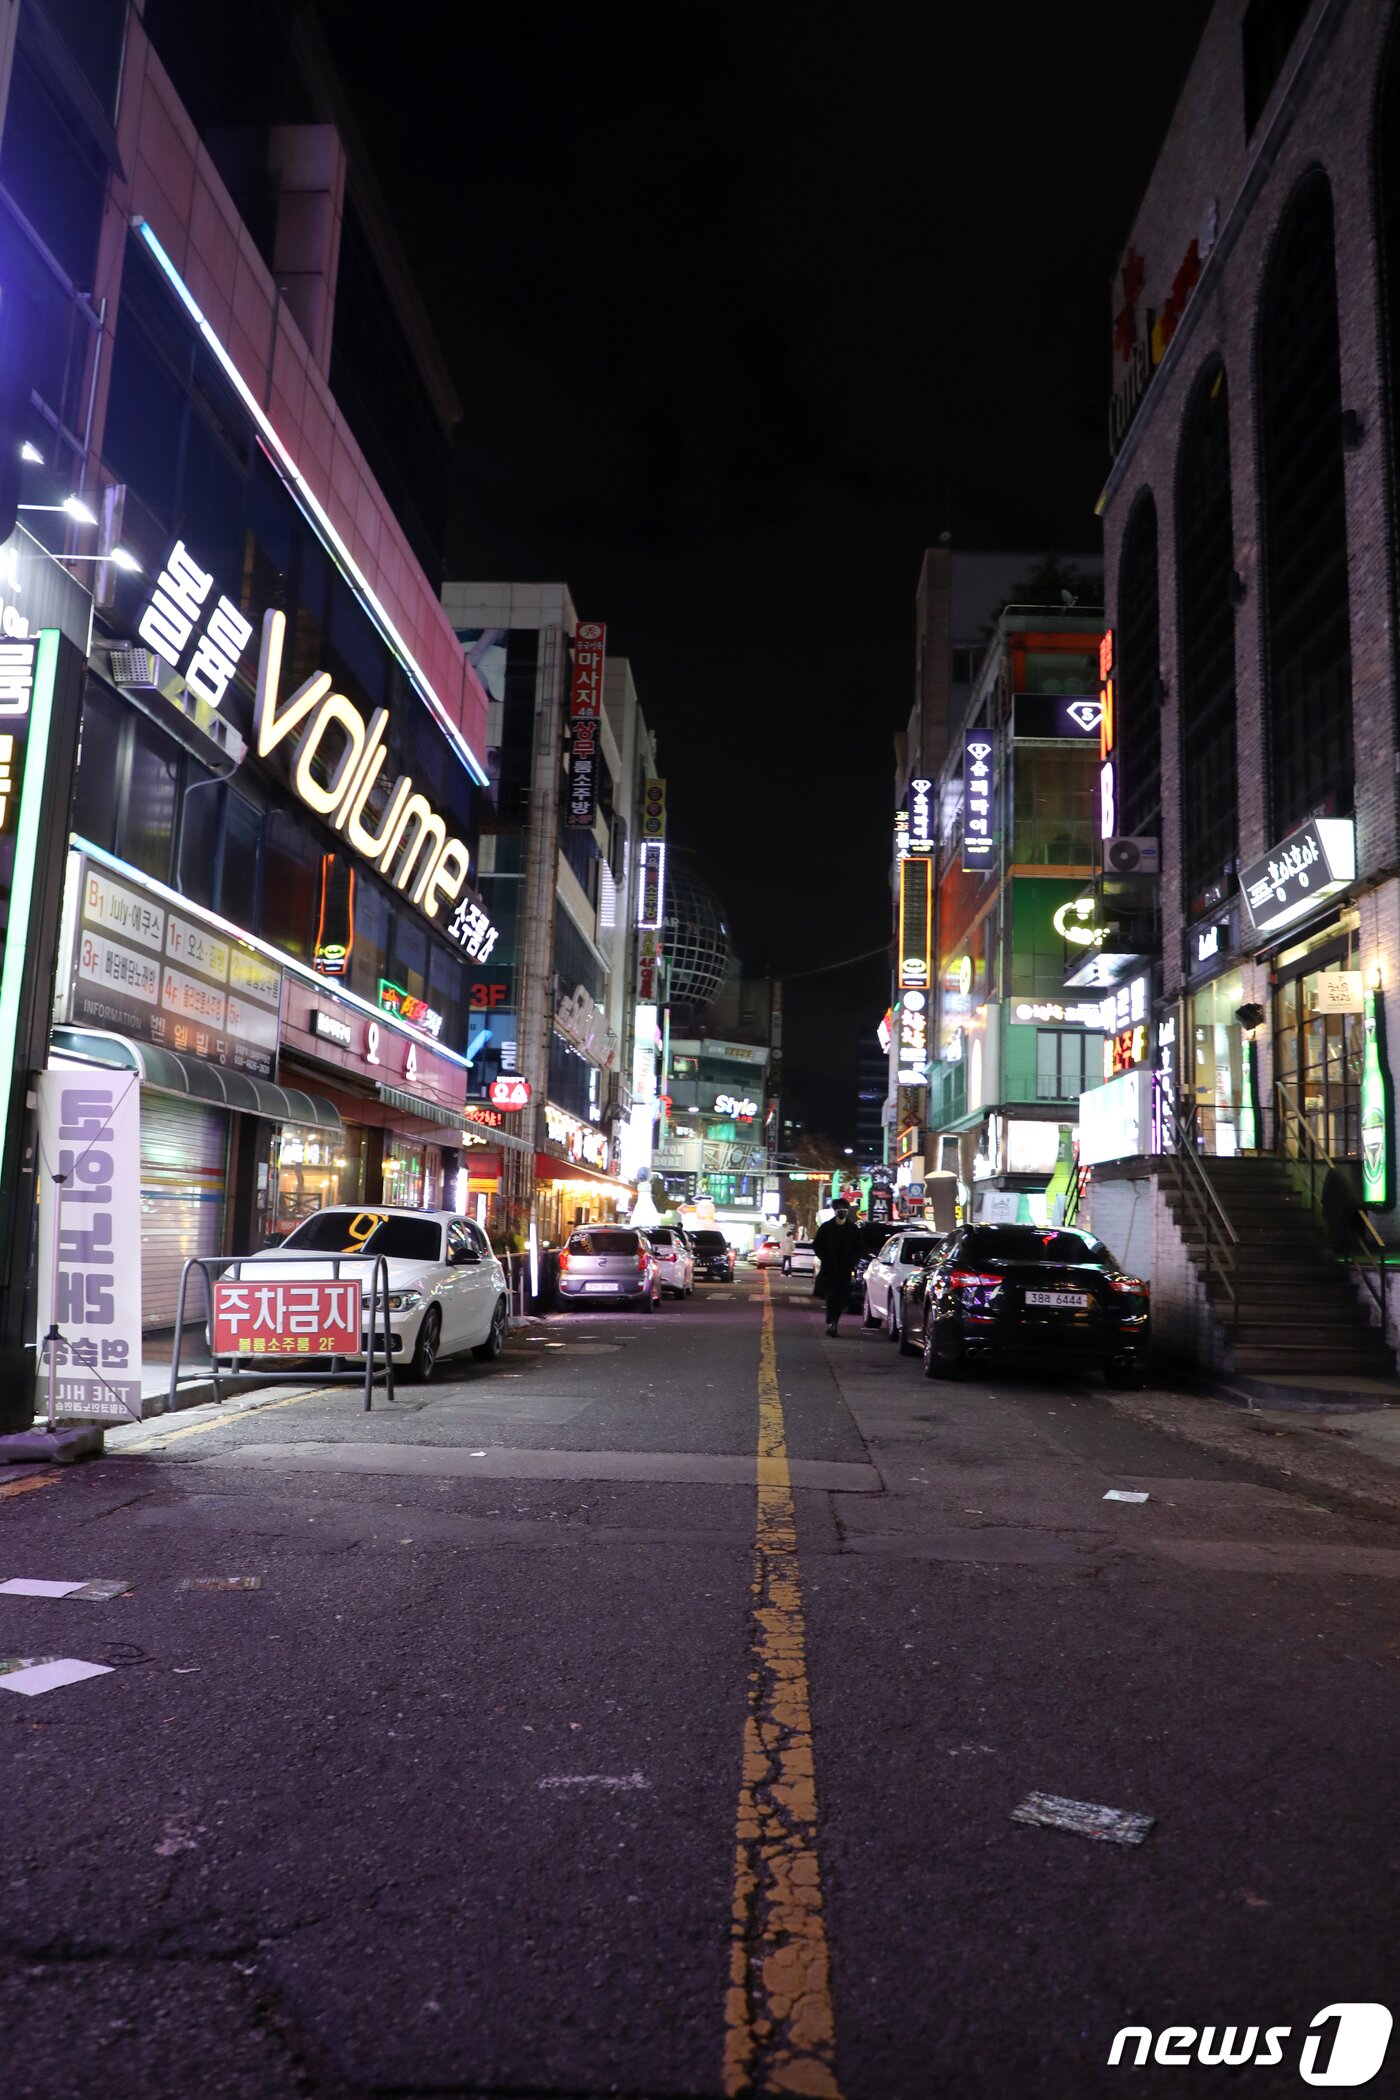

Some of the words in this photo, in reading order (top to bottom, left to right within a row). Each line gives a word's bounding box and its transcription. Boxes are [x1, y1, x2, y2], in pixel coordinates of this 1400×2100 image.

[576, 652, 600, 708] 마사지
[573, 721, 597, 760] 상무
[256, 608, 470, 917] Volume
[571, 760, 594, 815] 룸소주방
[88, 879, 105, 918] B1
[170, 922, 182, 953] 1F
[82, 939, 99, 974] 3F
[164, 975, 178, 1005] 4F
[470, 983, 508, 1008] 3F
[83, 999, 142, 1030] INFORMATION
[228, 1003, 240, 1032] 5F
[714, 1095, 758, 1119] Style
[218, 1286, 354, 1334] 주차금지
[1056, 1294, 1082, 1305] 6444
[238, 1337, 310, 1352] 볼륨소주룸
[319, 1337, 335, 1350] 2F
